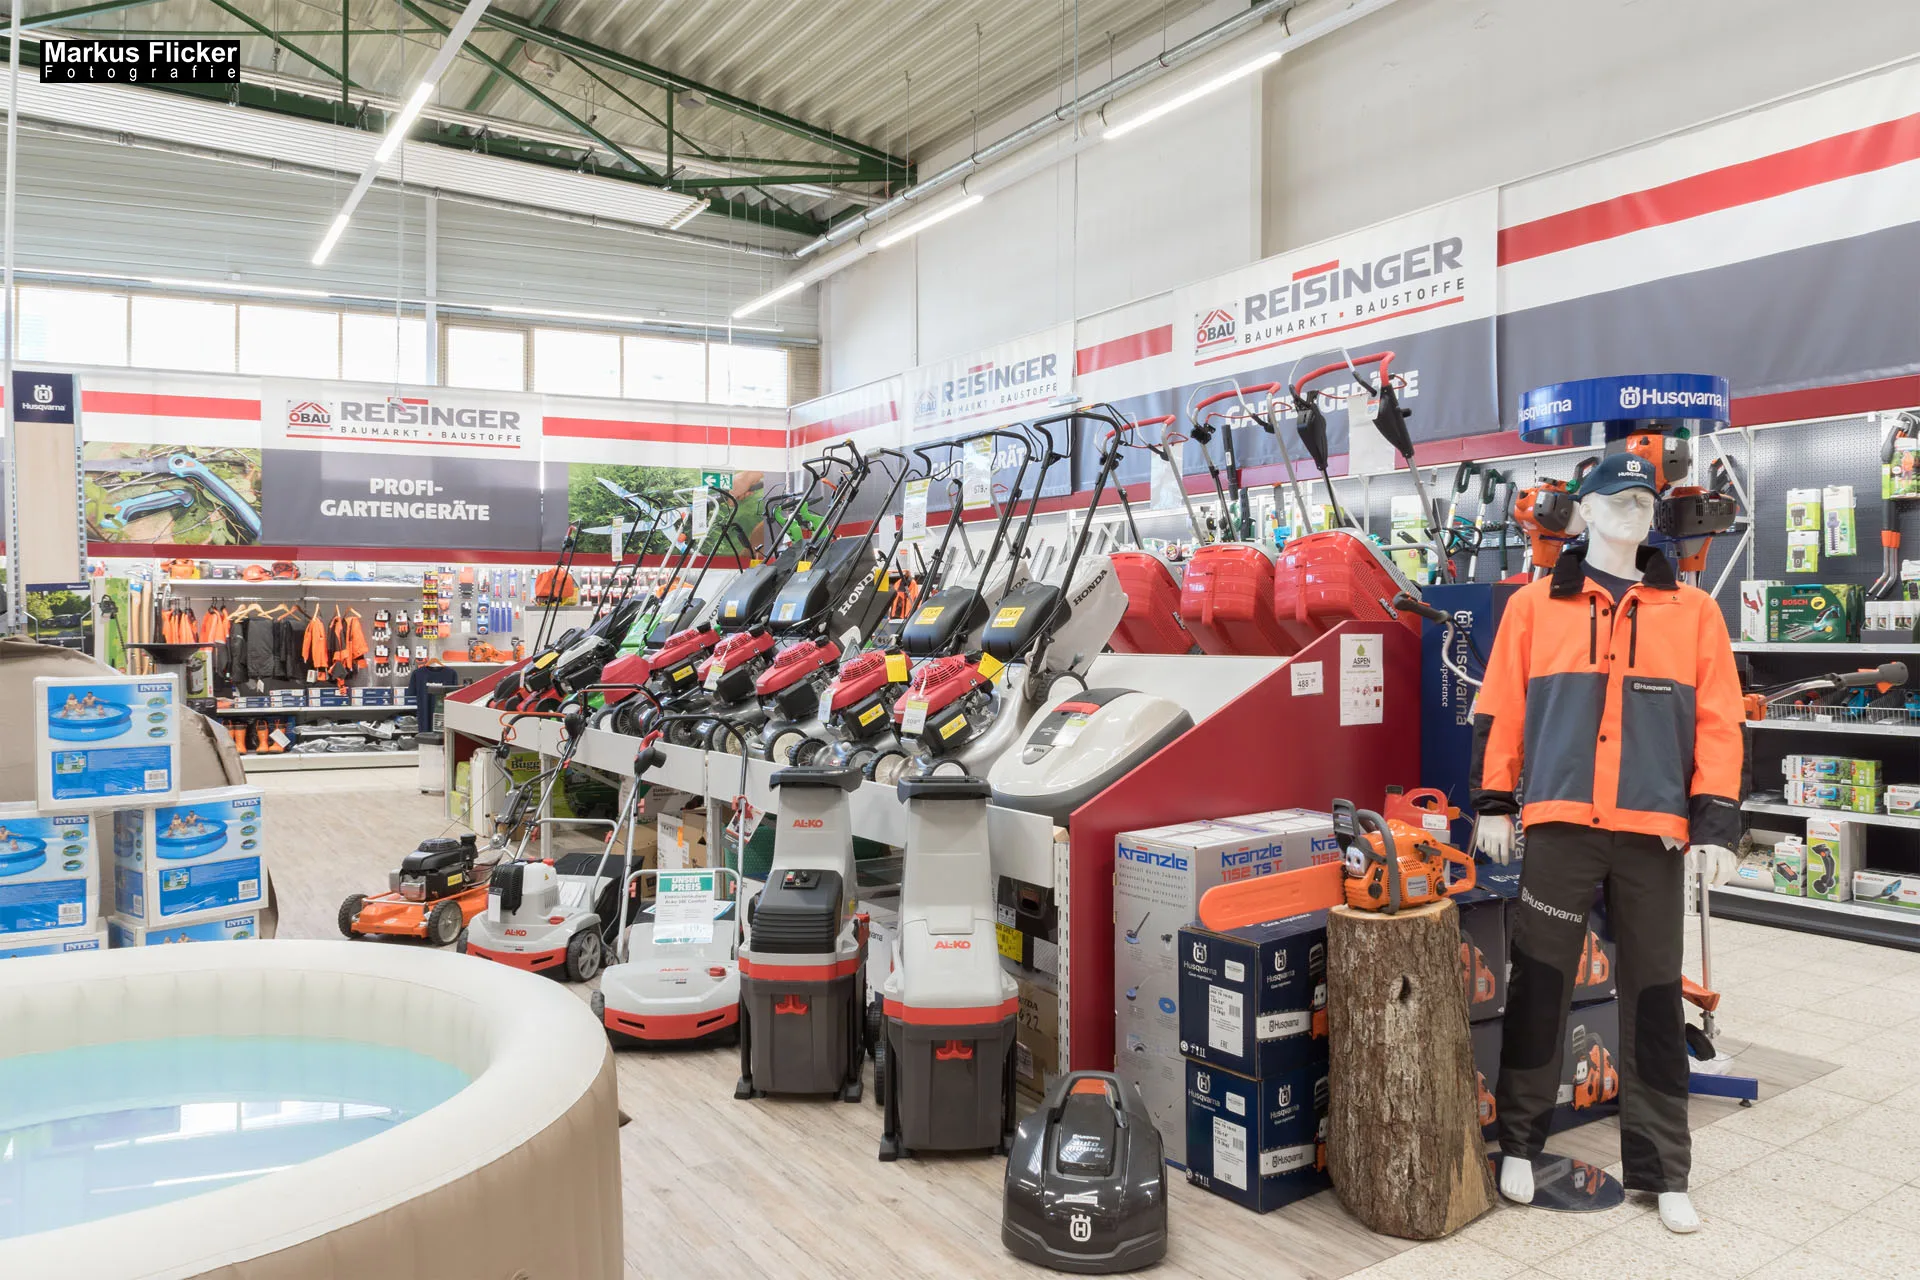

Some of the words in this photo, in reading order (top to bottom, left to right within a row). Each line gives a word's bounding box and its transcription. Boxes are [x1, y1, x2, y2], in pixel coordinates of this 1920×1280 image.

[1244, 236, 1464, 325] REISINGER
[1244, 313, 1328, 344] BAUMARKT
[1355, 277, 1465, 316] BAUSTOFFE
[941, 353, 1057, 402] REISINGER
[1642, 387, 1723, 409] Husqvarna
[22, 402, 66, 412] Husqvarna
[340, 397, 520, 430] REISINGER
[340, 426, 420, 438] BAUMARKT
[441, 431, 521, 443] BAUSTOFFE
[369, 478, 443, 496] PROFI-
[320, 499, 490, 521] GARTENGERÄTE
[1072, 569, 1108, 606] HONDA
[1781, 598, 1808, 606] BOSCH
[1353, 657, 1371, 665] ASPEN
[139, 684, 170, 692] INTEX
[1640, 684, 1672, 692] Husqvarna
[55, 816, 86, 824] INTEX
[1311, 834, 1339, 852] krä
[1118, 843, 1188, 871] kränzle
[1221, 843, 1283, 868] kränzle
[1221, 866, 1251, 882] 1152
[1253, 862, 1272, 876] TS
[1273, 860, 1283, 872] T
[671, 883, 701, 891] PREIS
[1526, 893, 1583, 923] Husqvarna
[226, 919, 253, 927] INTEX
[66, 942, 97, 950] INTEX
[1183, 960, 1217, 976] Husqvarna
[1267, 970, 1295, 984] Husqvarna
[1274, 1019, 1299, 1030] Husqvarna
[1188, 1088, 1221, 1107] Husqvarna
[1270, 1104, 1300, 1119] Husqvarna
[1277, 1152, 1303, 1165] Husqvarna
